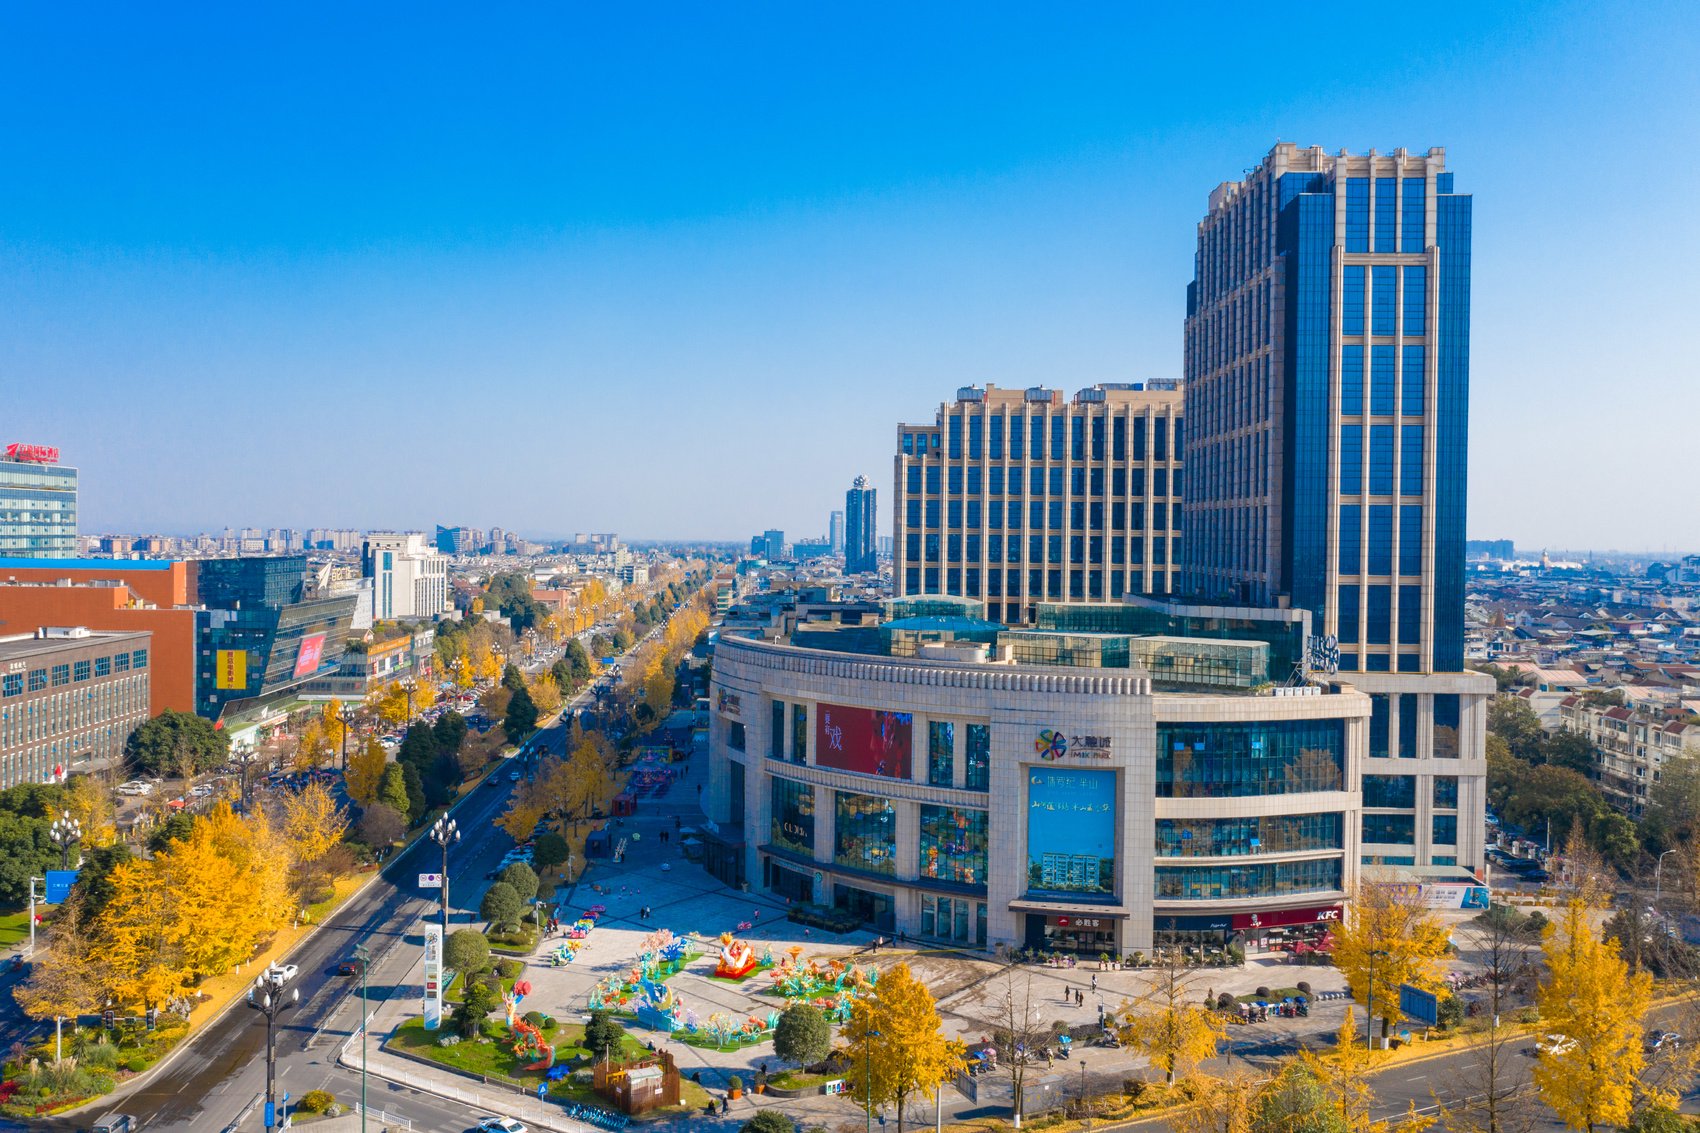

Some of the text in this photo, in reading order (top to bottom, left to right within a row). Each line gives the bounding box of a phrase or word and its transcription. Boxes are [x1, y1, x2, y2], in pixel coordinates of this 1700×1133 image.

[1071, 735, 1112, 748] 大融城
[1316, 910, 1339, 921] KFC
[1075, 918, 1100, 928] 必胜客
